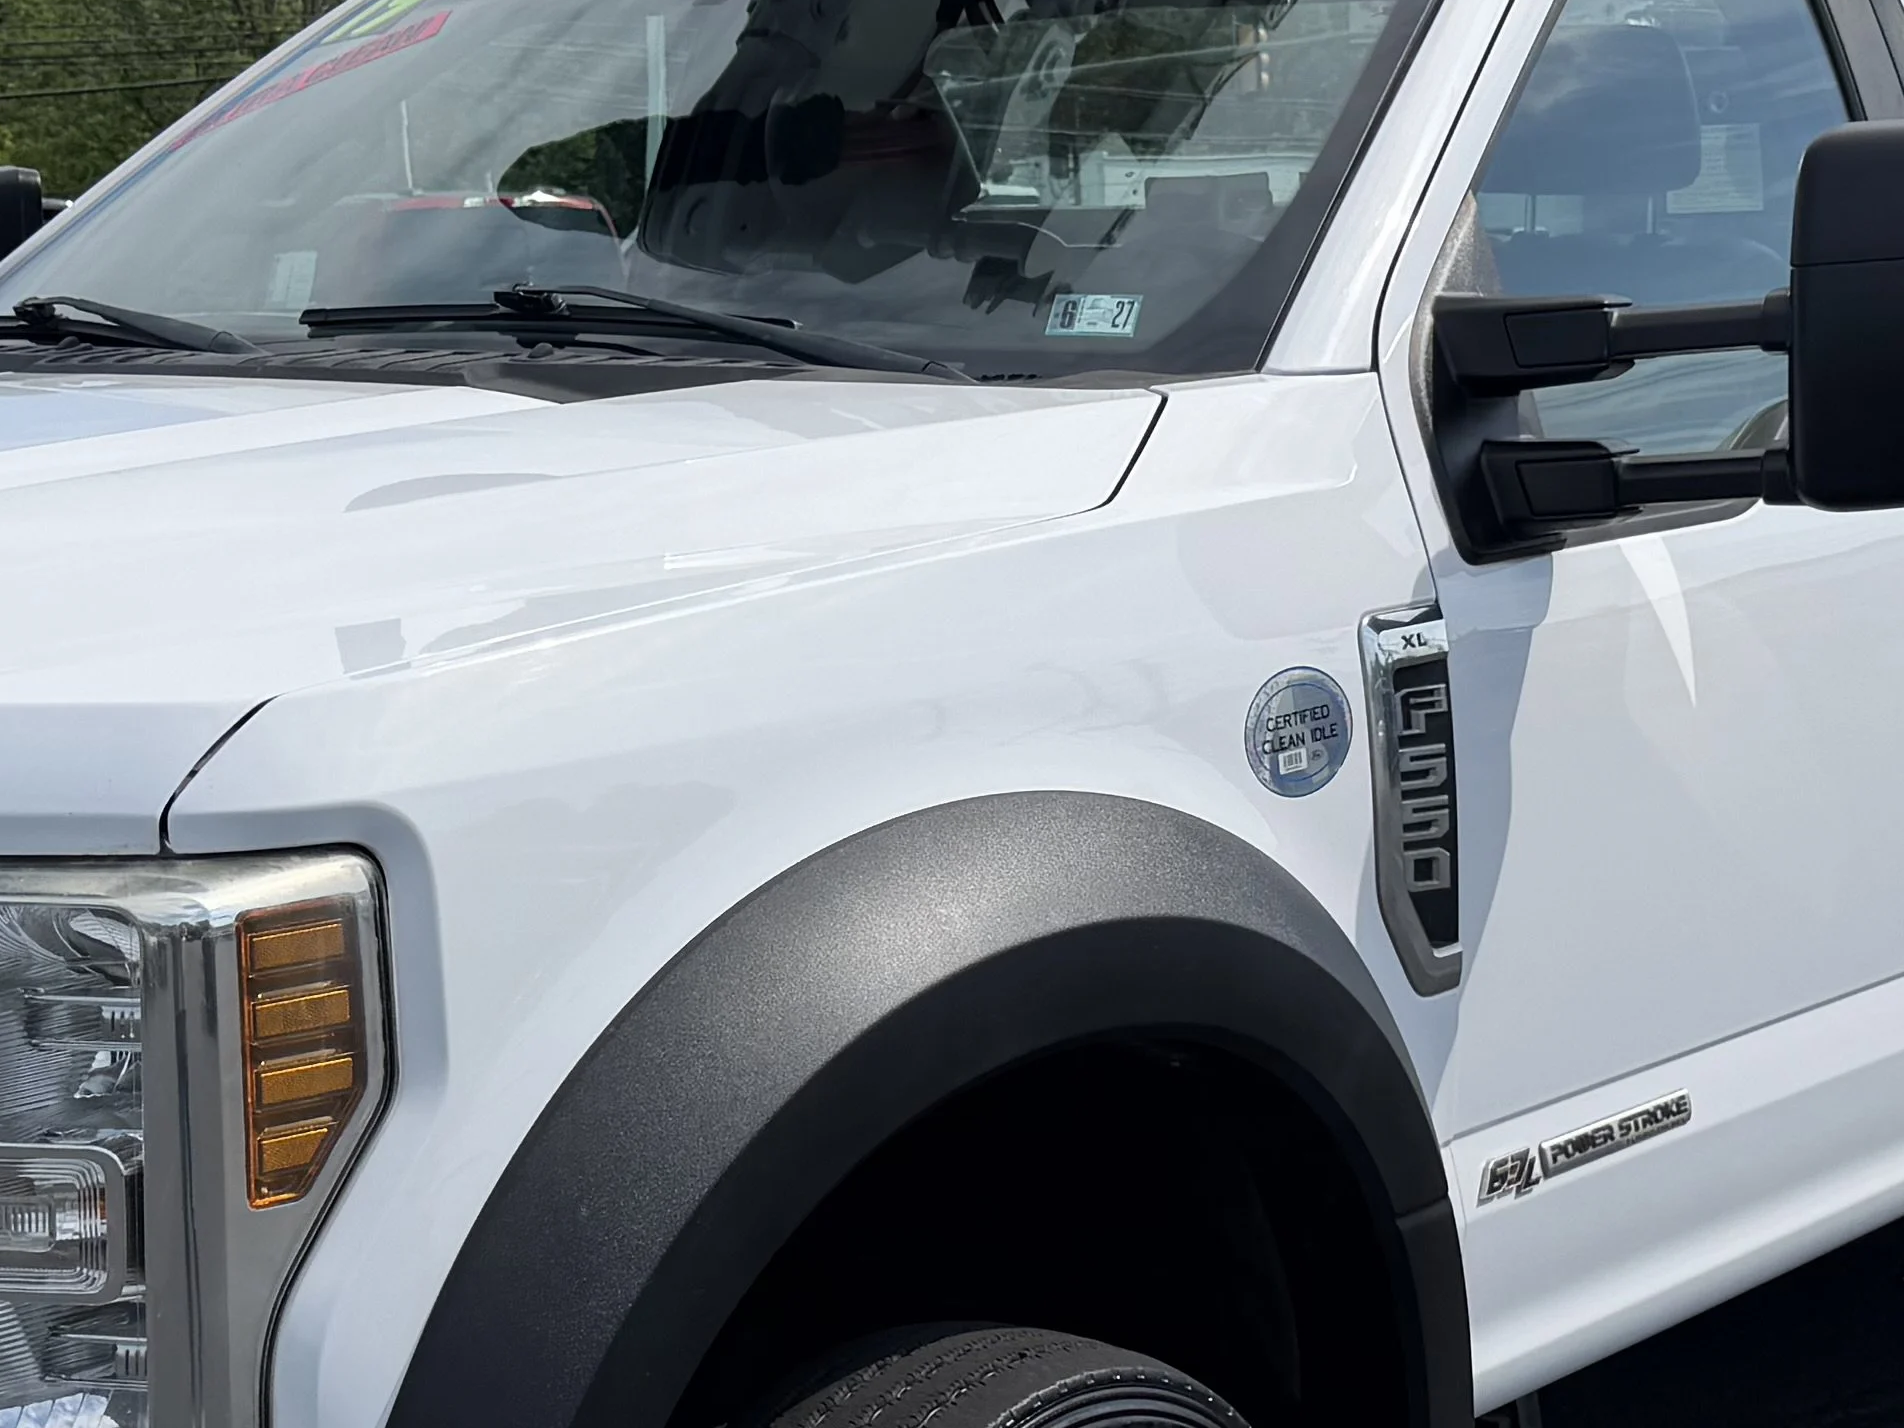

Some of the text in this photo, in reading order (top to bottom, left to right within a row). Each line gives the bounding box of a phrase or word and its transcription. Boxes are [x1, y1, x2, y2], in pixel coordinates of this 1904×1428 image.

[1111, 300, 1135, 330] 27
[1401, 632, 1427, 650] XL
[1266, 704, 1330, 732] CERTIFIED
[1262, 722, 1339, 754] CLEAN IDLE
[1549, 1123, 1616, 1166] POWER
[1618, 1094, 1690, 1138] STROKE
